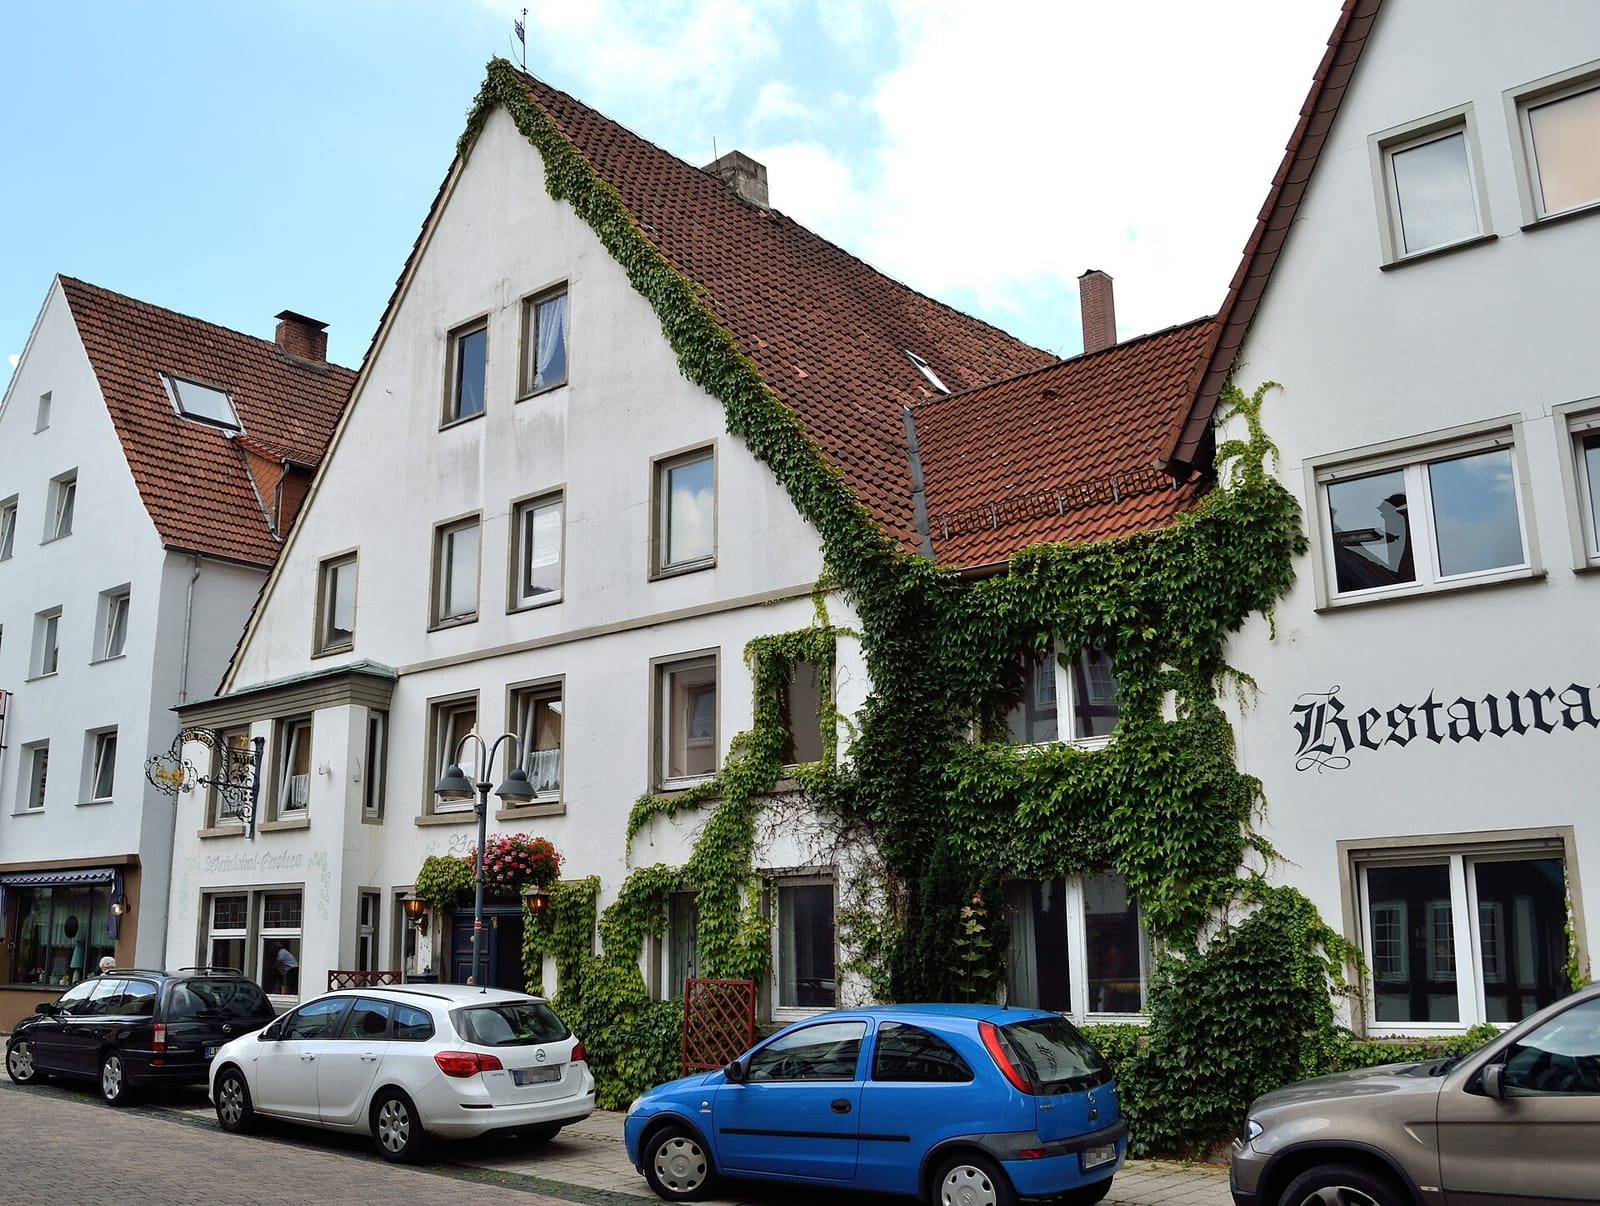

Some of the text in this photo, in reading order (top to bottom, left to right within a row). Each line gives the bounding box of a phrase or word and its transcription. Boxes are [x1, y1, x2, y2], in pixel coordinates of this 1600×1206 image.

[181, 732, 215, 747] ZUR POST
[1289, 682, 1600, 774] Restaura
